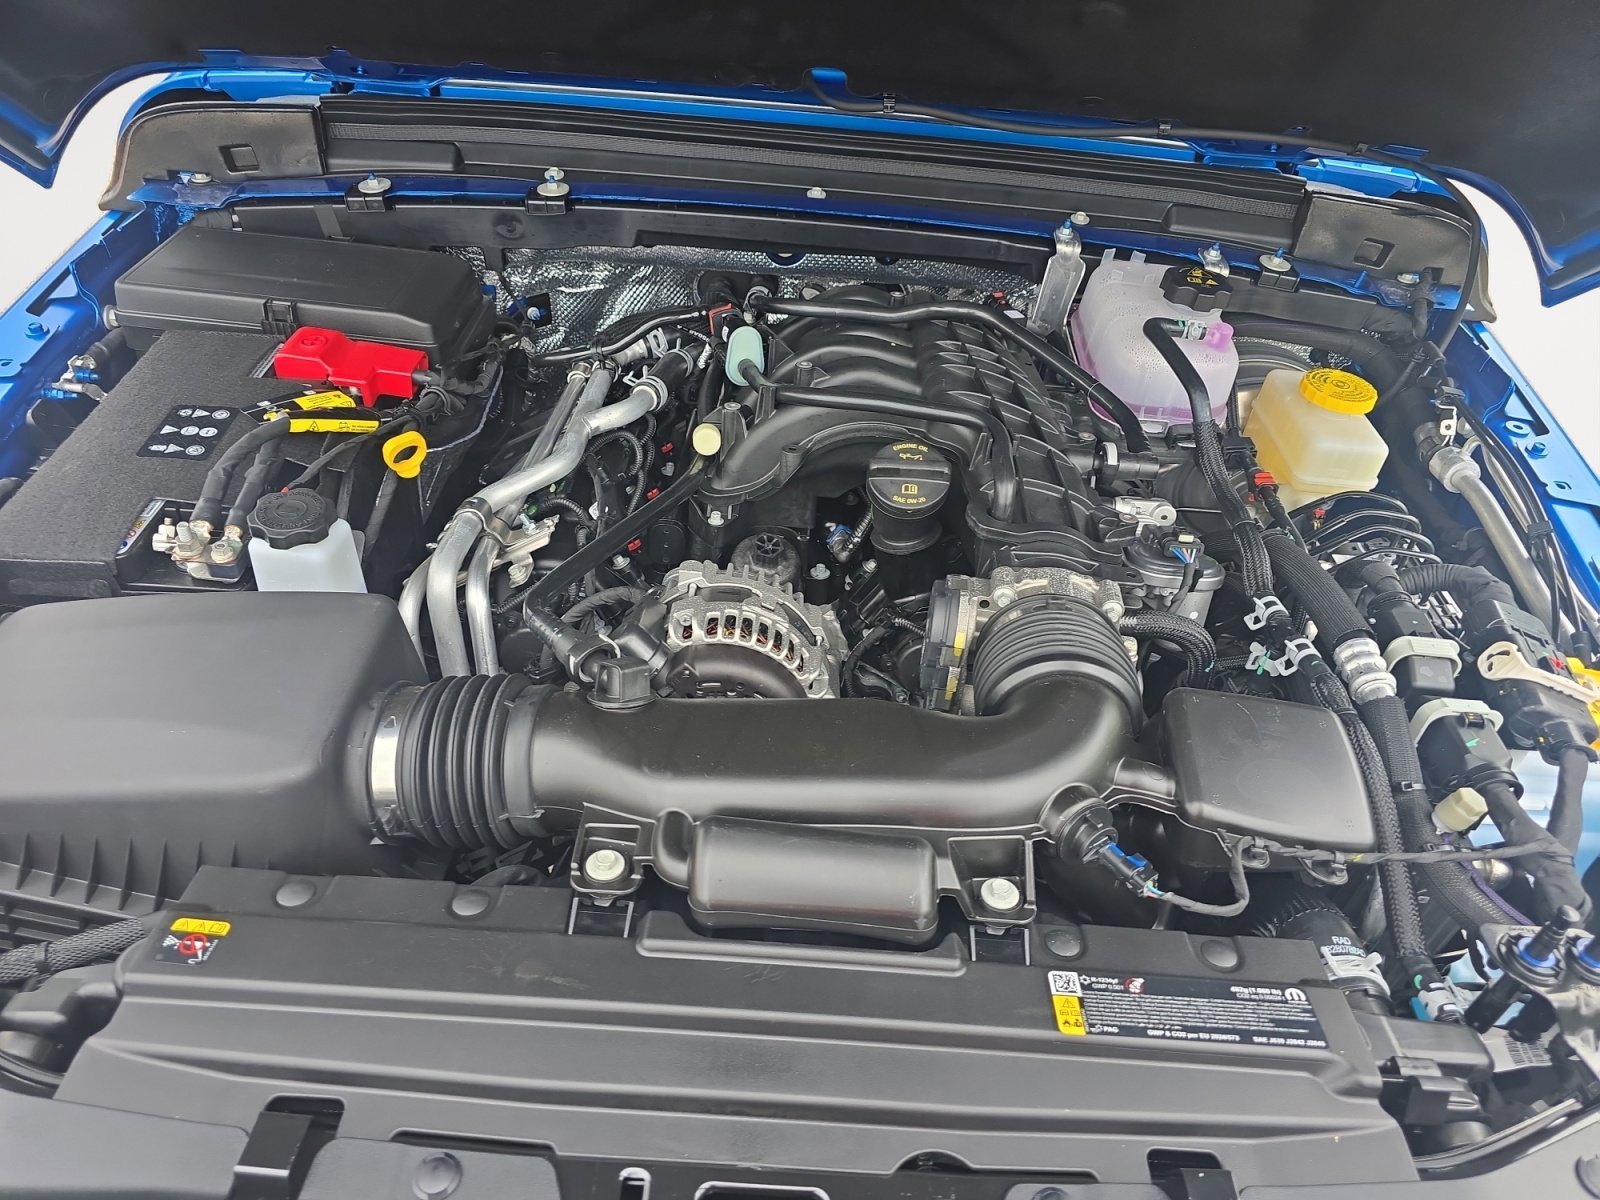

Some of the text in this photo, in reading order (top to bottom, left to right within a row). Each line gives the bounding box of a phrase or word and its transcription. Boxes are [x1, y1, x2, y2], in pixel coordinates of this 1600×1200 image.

[892, 443, 917, 451] ENGINE
[892, 495, 927, 504] SAE 0W-20
[1331, 935, 1352, 945] RAD
[1103, 1026, 1119, 1034] PAG
[1147, 1029, 1165, 1037] GWP
[1172, 1030, 1187, 1038] CO2
[1187, 1032, 1199, 1040] per
[1199, 1032, 1210, 1040] EU
[1252, 1036, 1268, 1044] SAE
